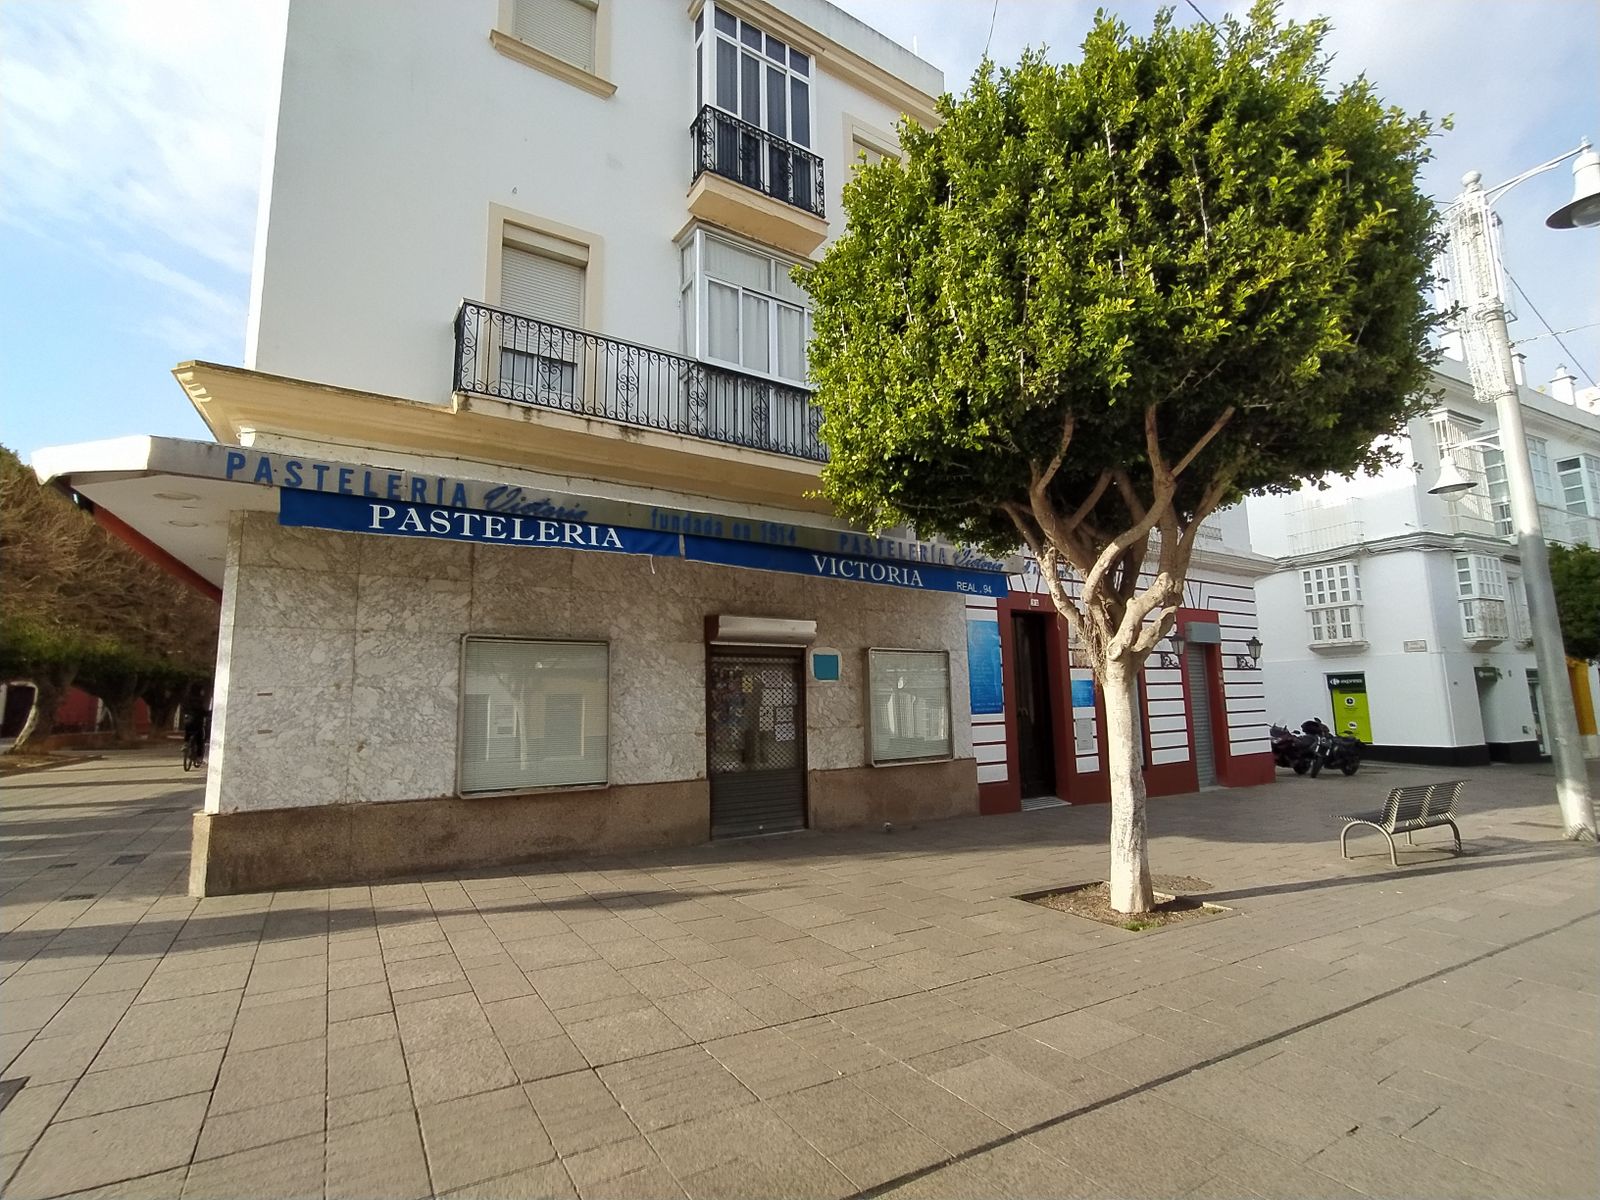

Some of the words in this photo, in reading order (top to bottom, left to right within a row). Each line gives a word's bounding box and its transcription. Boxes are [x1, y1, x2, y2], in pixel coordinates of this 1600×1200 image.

[483, 485, 588, 521] Victoria
[368, 504, 624, 549] PASTELERIA
[651, 507, 723, 537] fundada
[731, 523, 751, 540] en
[760, 522, 797, 545] 1914
[812, 554, 925, 588] VICTORIA
[956, 580, 978, 593] REAL
